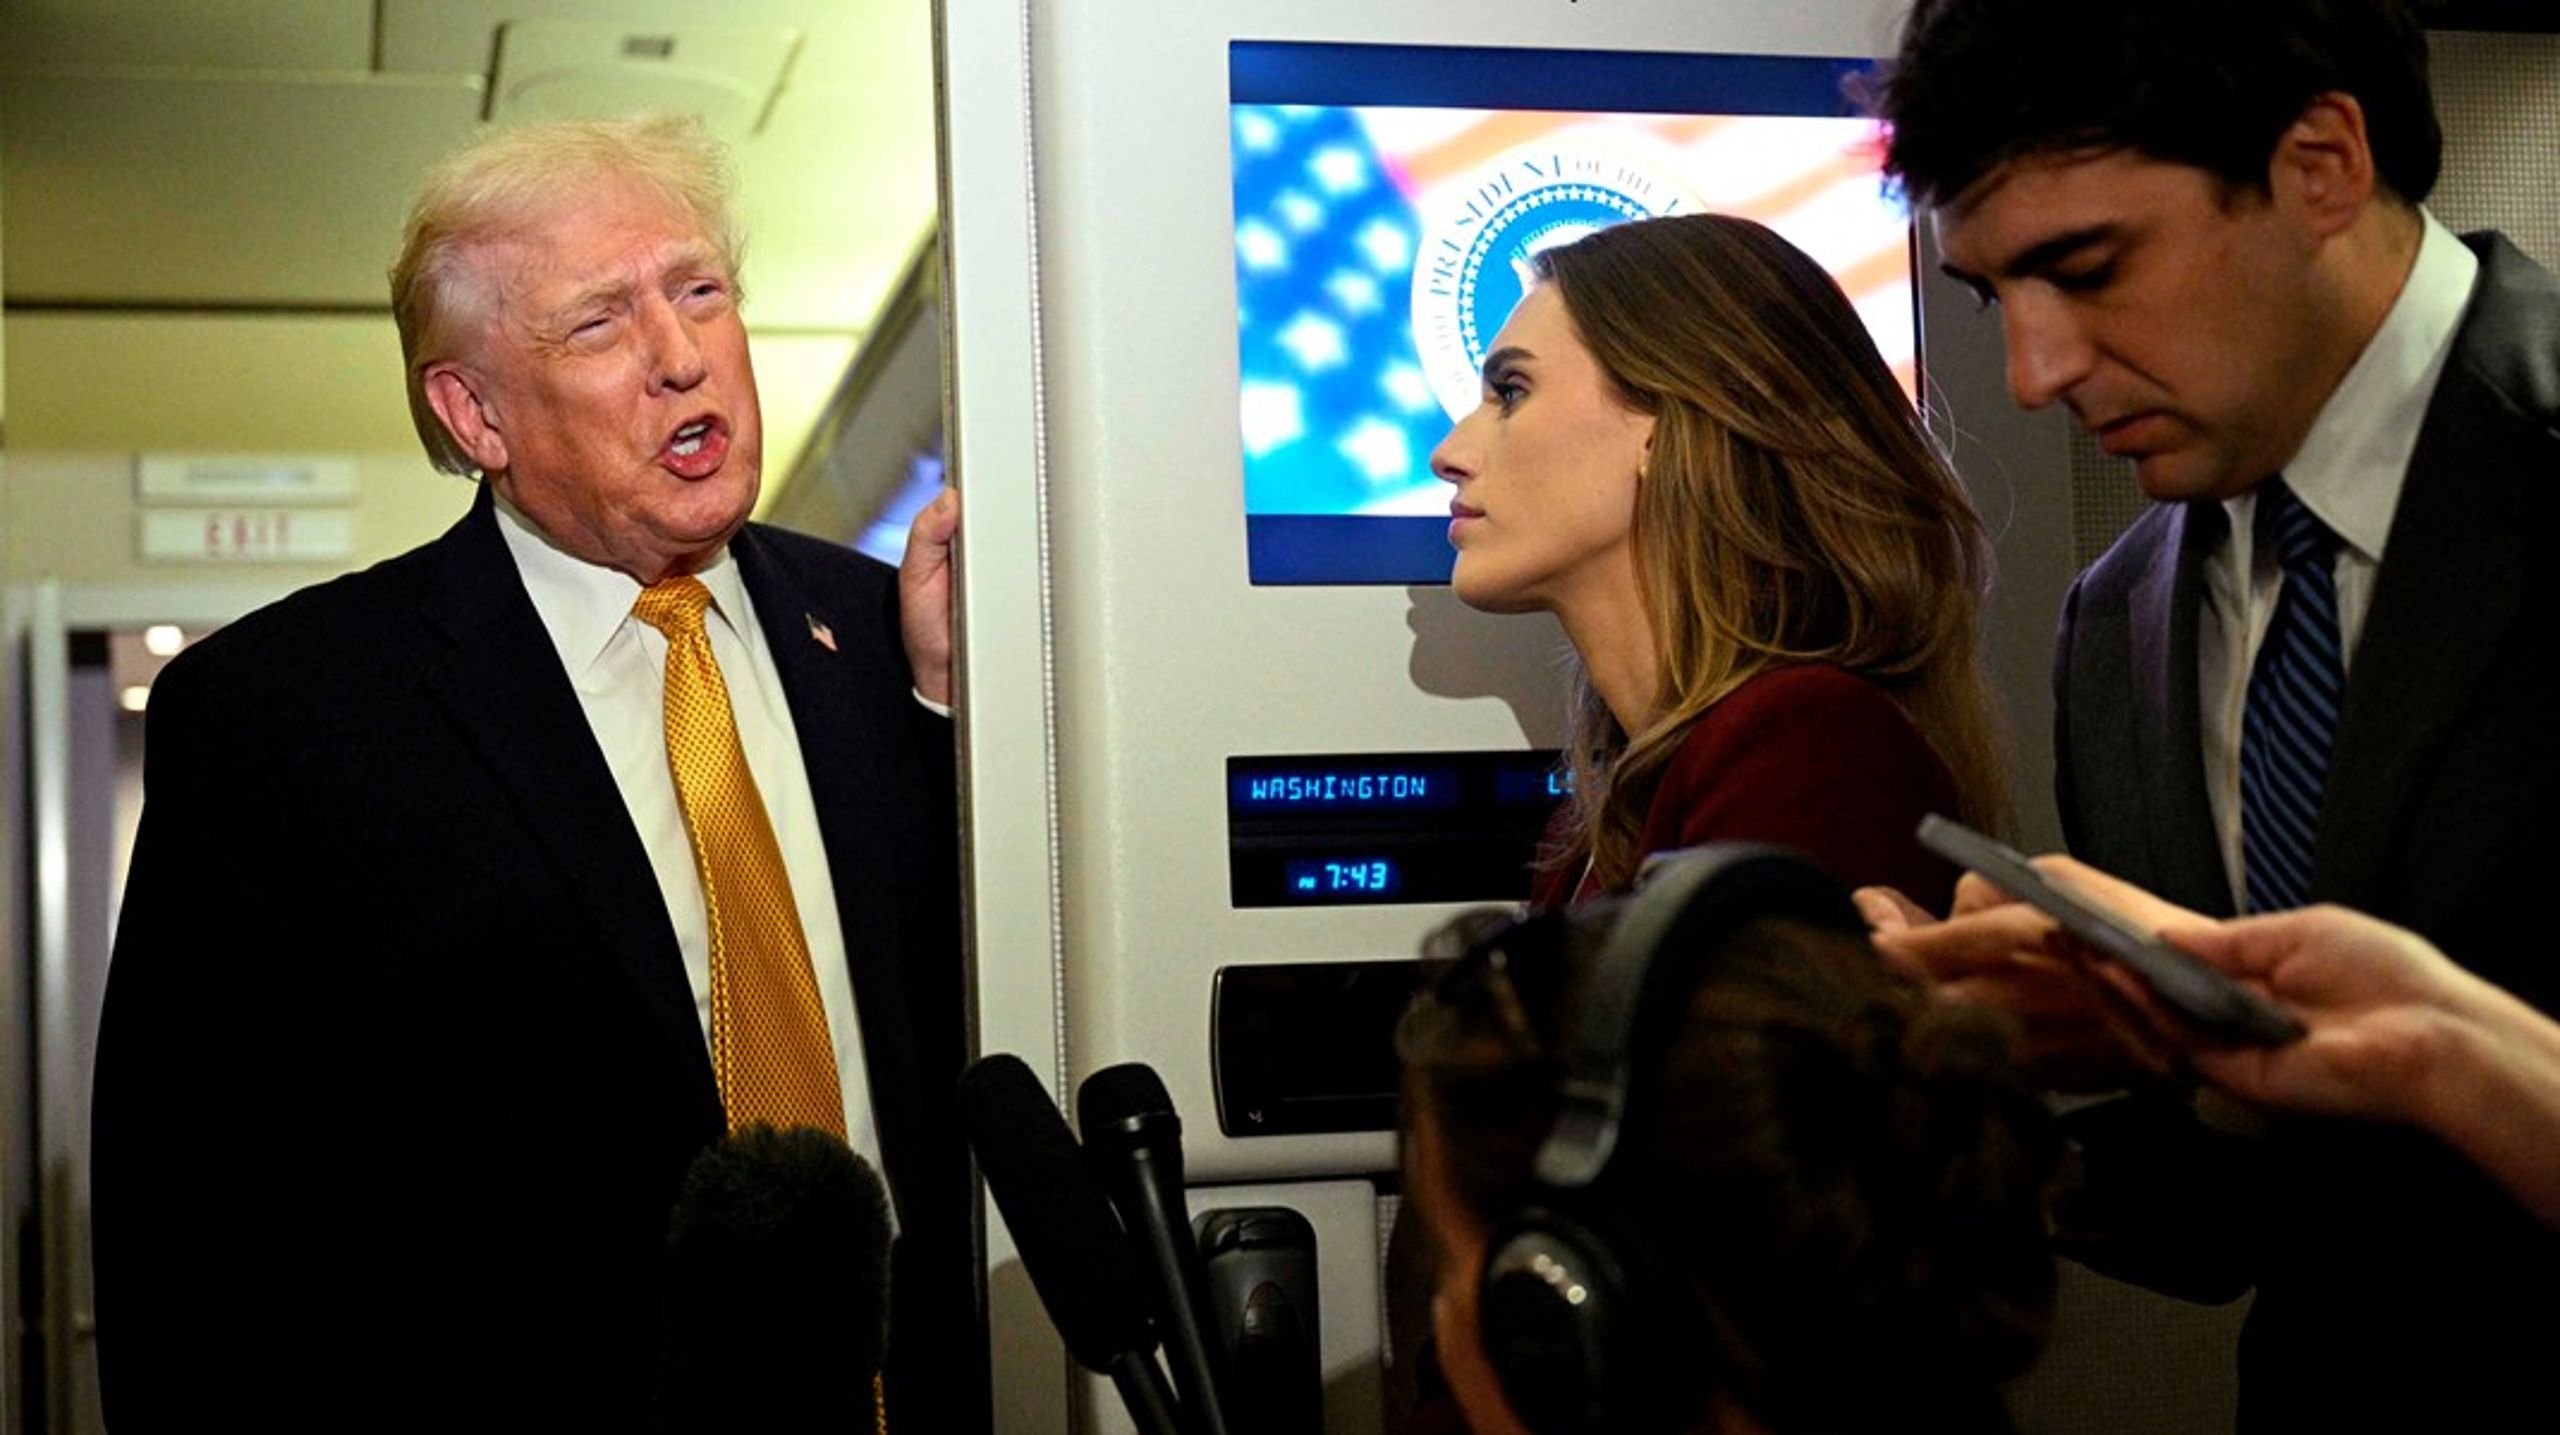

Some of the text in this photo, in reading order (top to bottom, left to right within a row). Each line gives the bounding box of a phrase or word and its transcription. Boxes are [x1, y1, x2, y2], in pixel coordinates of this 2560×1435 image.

[1429, 154, 1562, 297] PRESIDENT
[1251, 775, 1425, 800] WASHINGTON
[1325, 863, 1387, 889] 7:43
